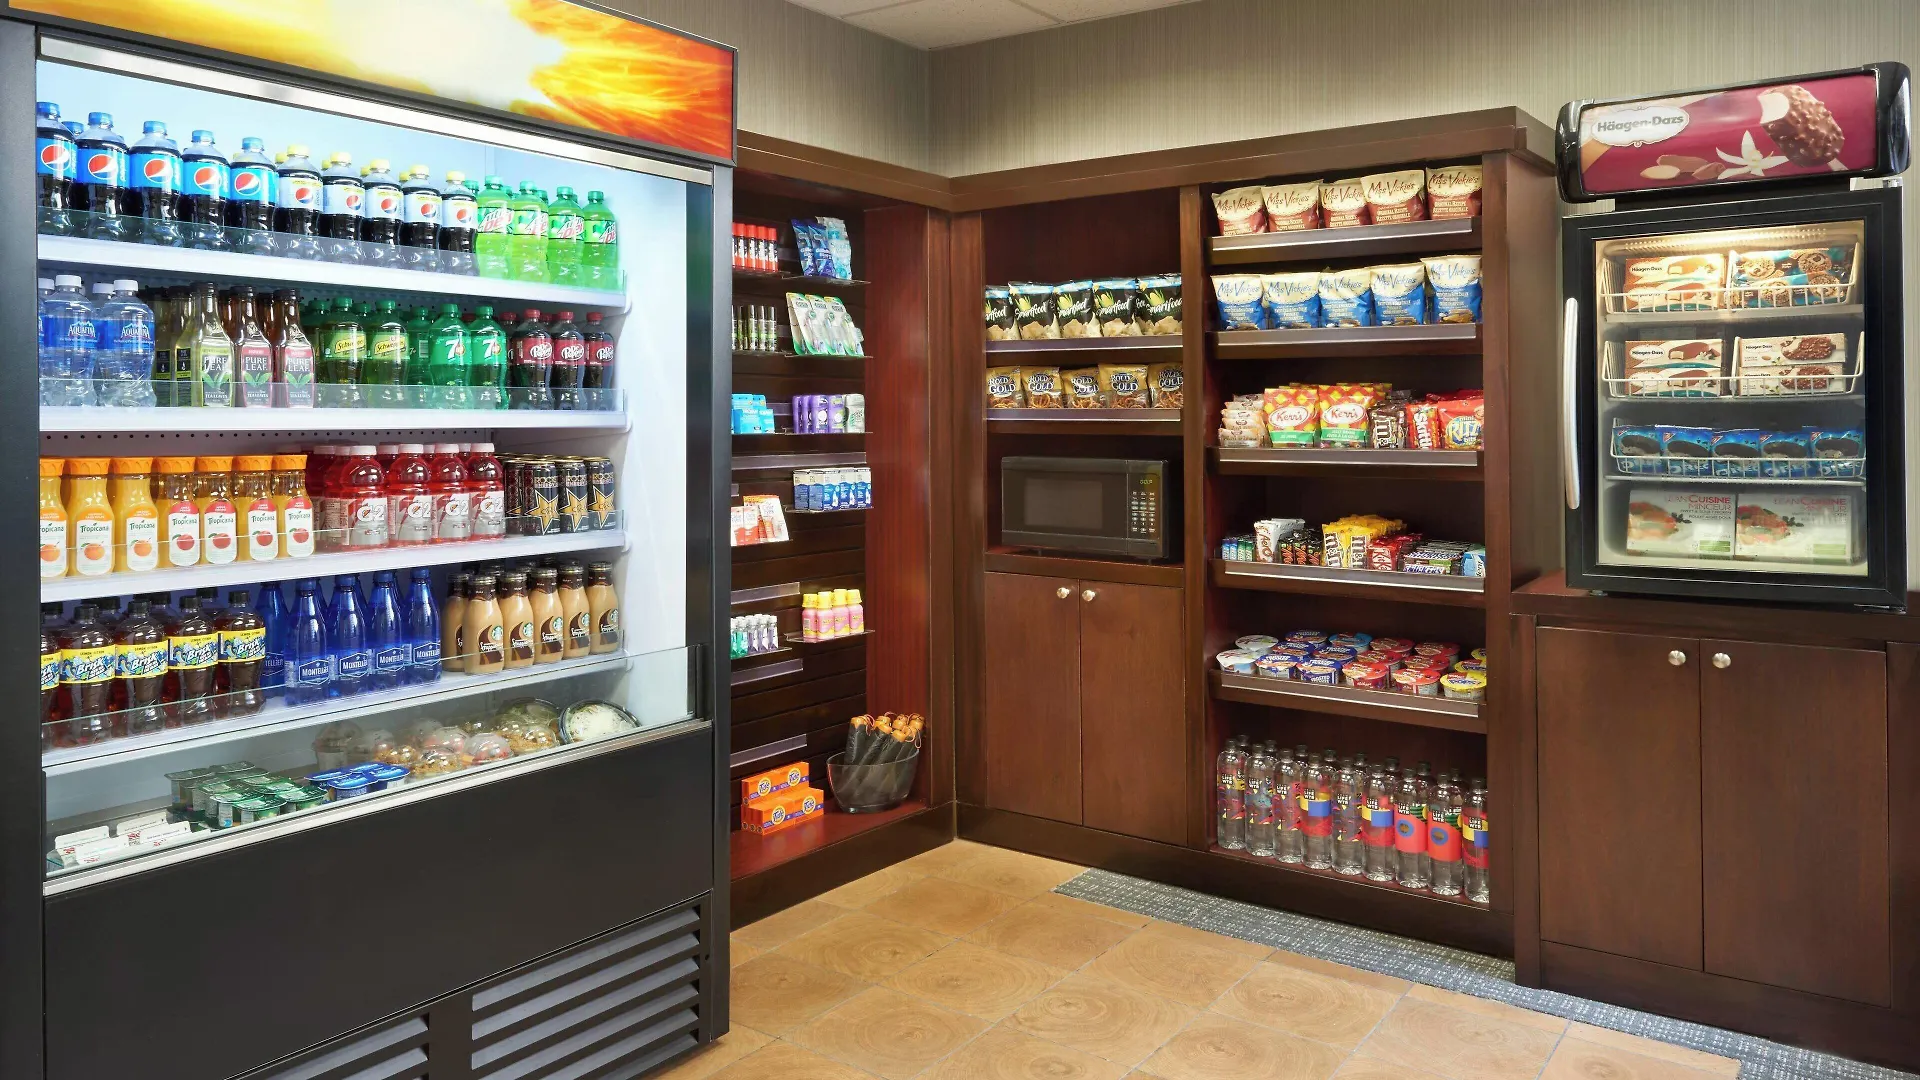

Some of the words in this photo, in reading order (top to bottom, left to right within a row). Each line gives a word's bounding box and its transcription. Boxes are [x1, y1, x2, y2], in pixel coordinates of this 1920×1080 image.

[1597, 116, 1684, 132] Häagen-Dazs
[1429, 171, 1448, 189] Miss
[1448, 172, 1479, 190] Vickie's
[1323, 185, 1339, 203] Miss
[1339, 184, 1363, 202] Vickie
[1368, 181, 1386, 199] Miss
[1386, 179, 1415, 197] Vickie's
[1266, 191, 1283, 208] Miss
[1217, 198, 1232, 214] Miss
[1014, 301, 1048, 320] Smartfood
[1632, 349, 1664, 357] Häagen-Dazs
[245, 356, 268, 364] PURE
[287, 357, 310, 365] PURE
[246, 363, 268, 371] LEAF
[288, 364, 310, 372] LEAF
[988, 376, 1009, 385] ROLD
[1028, 375, 1048, 384] ROLD
[1111, 373, 1132, 383] ROLD
[989, 383, 1016, 394] GOLD
[1028, 381, 1054, 391] GOLD
[1111, 381, 1138, 391] GOLD
[1276, 411, 1303, 422] Kerr's
[1331, 407, 1358, 418] Kerr's
[1448, 420, 1482, 441] RITZ
[1689, 494, 1731, 504] CUISINE
[1688, 503, 1731, 511] MINCEUR
[208, 517, 234, 525] Tropicana
[252, 515, 275, 523] Tropicana
[288, 512, 311, 520] Tropicana
[130, 522, 156, 530] Tropicana
[172, 518, 198, 526] Tropicana
[79, 524, 109, 533] Tropicana
[379, 653, 404, 664] MONTELLIE
[416, 648, 441, 659] MONTELLIE
[76, 657, 104, 675] Brisk
[131, 651, 158, 670] Brisk
[342, 659, 368, 670] MONTELLIE
[302, 665, 329, 677] MONTELLIE
[789, 771, 801, 784] Tide
[758, 781, 771, 795] Tide
[802, 799, 815, 811] Tide
[772, 810, 784, 822] Tide
